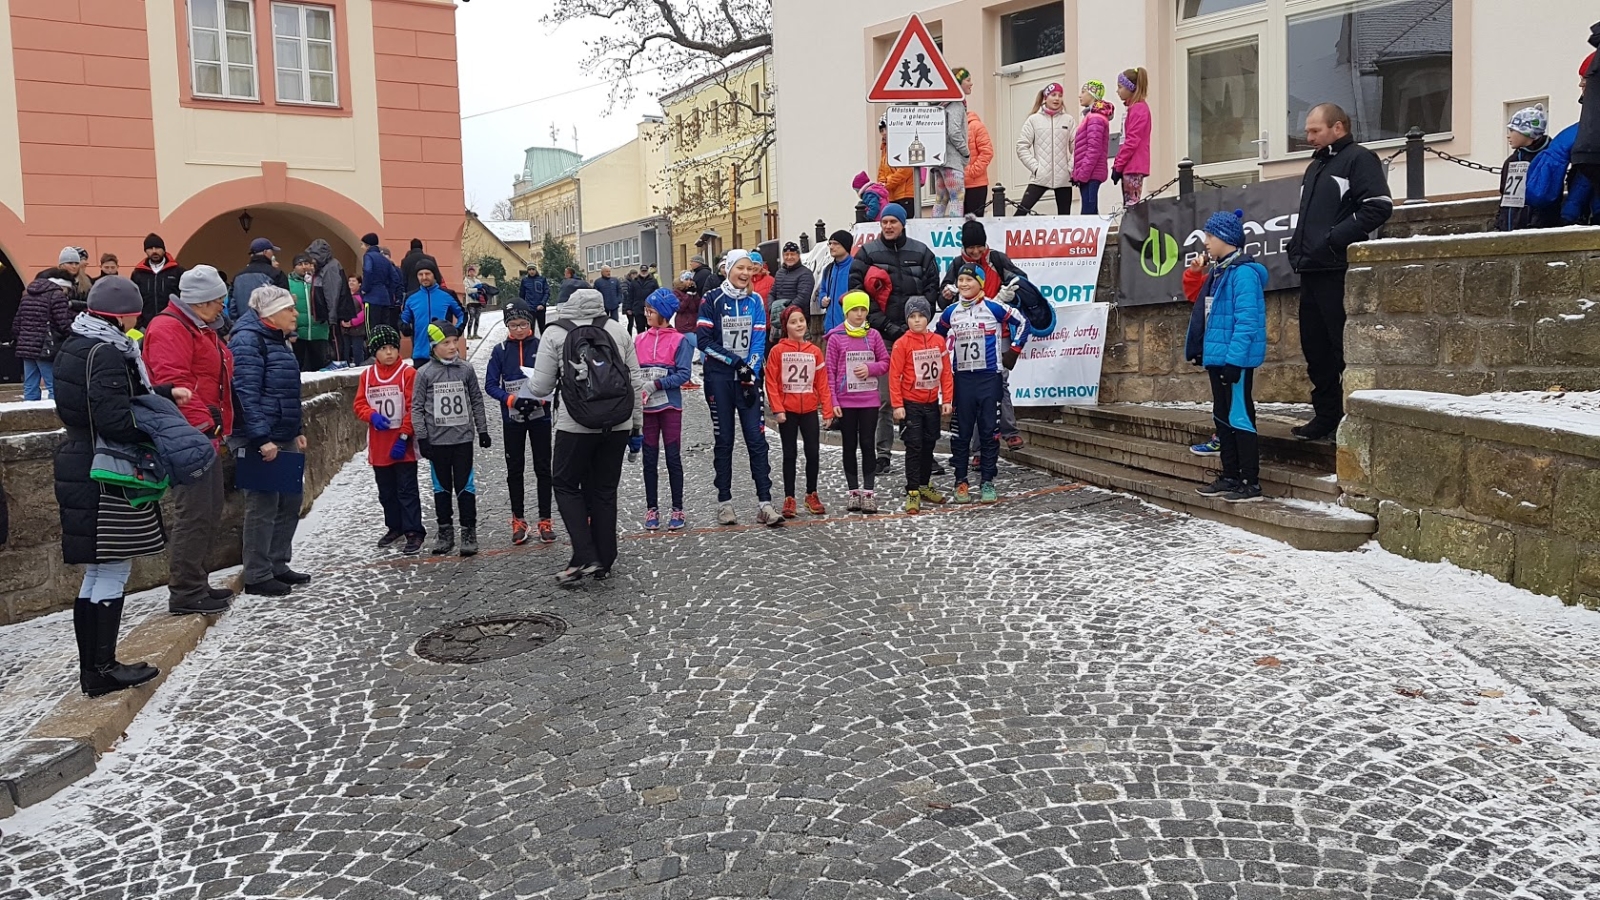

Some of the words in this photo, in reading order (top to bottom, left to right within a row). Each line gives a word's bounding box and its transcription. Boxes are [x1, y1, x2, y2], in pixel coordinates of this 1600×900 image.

[1503, 175, 1524, 196] 27
[1005, 227, 1101, 247] MARATON
[1069, 246, 1095, 255] stav
[1014, 261, 1046, 269] ovýchovná
[1040, 284, 1095, 302] PORT
[730, 329, 749, 349] 75
[960, 341, 981, 361] 73
[788, 364, 809, 383] 24
[921, 360, 939, 381] 26
[1015, 387, 1031, 399] NA
[375, 398, 396, 418] 70
[440, 395, 463, 416] 88
